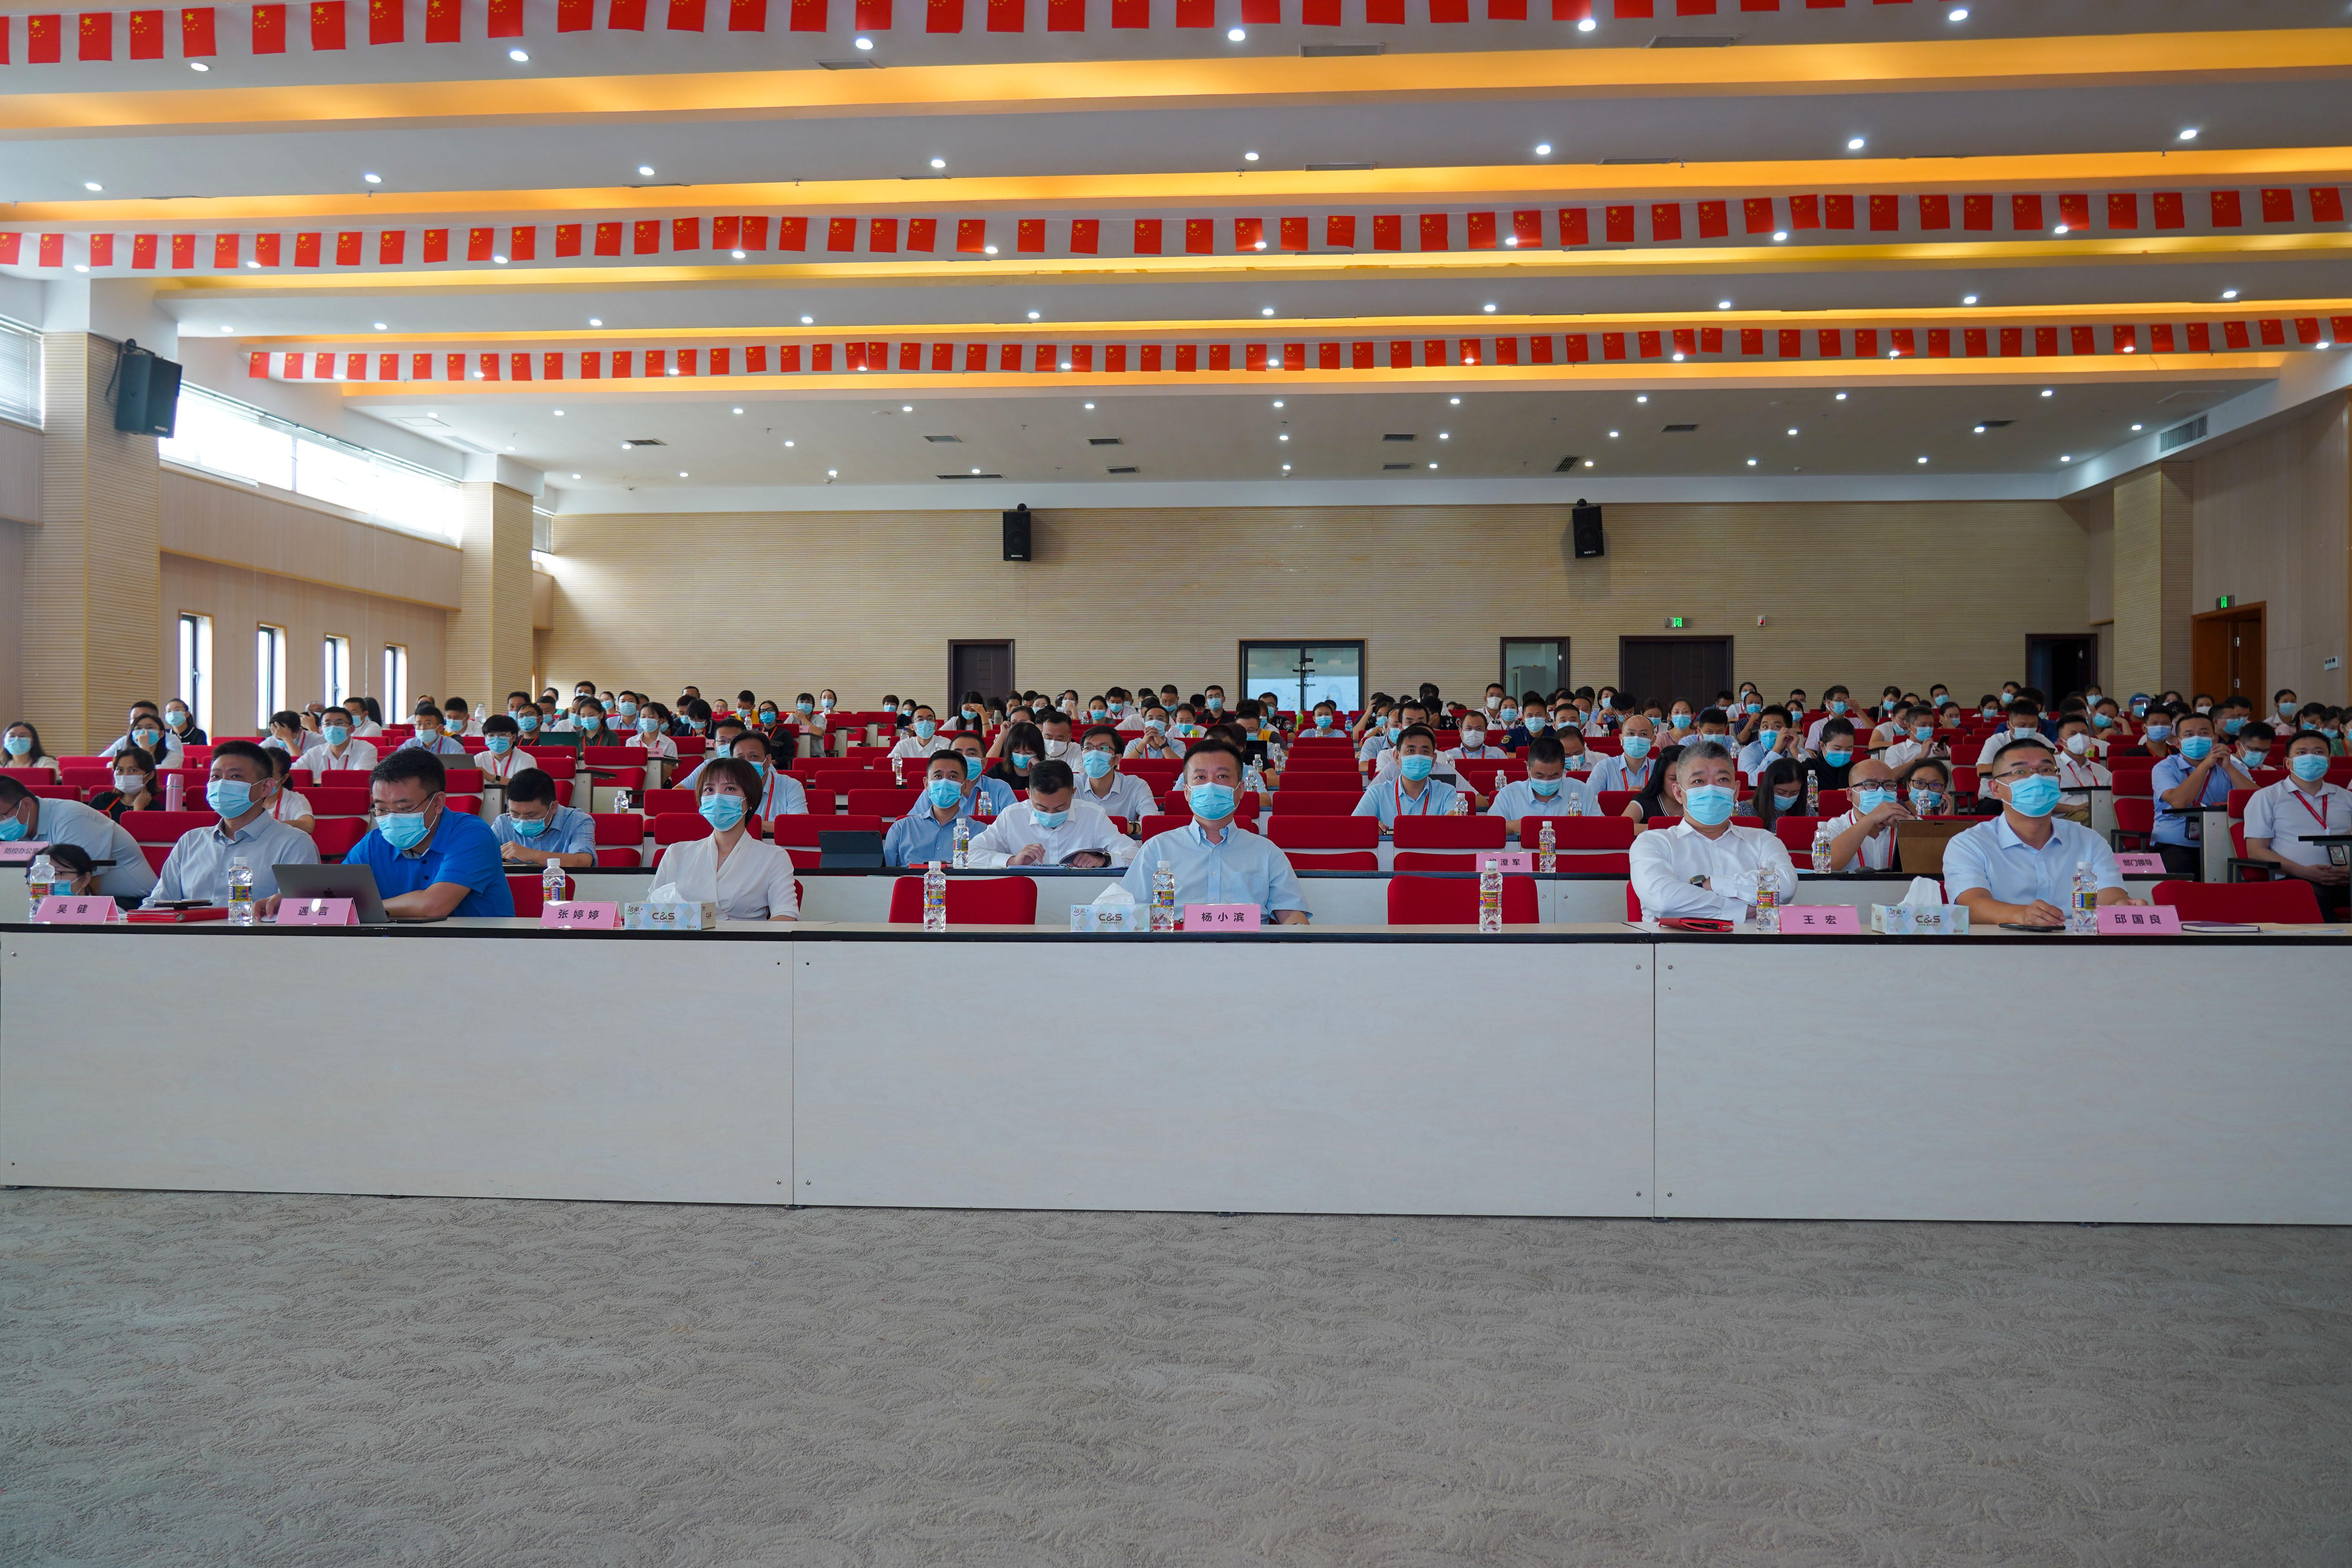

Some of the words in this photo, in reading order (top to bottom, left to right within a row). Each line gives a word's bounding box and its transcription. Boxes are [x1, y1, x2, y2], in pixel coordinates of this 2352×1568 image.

[57, 904, 88, 913] 吴健
[558, 909, 599, 919] 张婷婷
[652, 912, 675, 920] C&S
[1099, 913, 1122, 921] C&S
[1201, 912, 1244, 922] 杨小滨
[1803, 915, 1836, 924] 王宏
[1916, 915, 1940, 923] C&S
[2114, 914, 2161, 924] 邱国良
